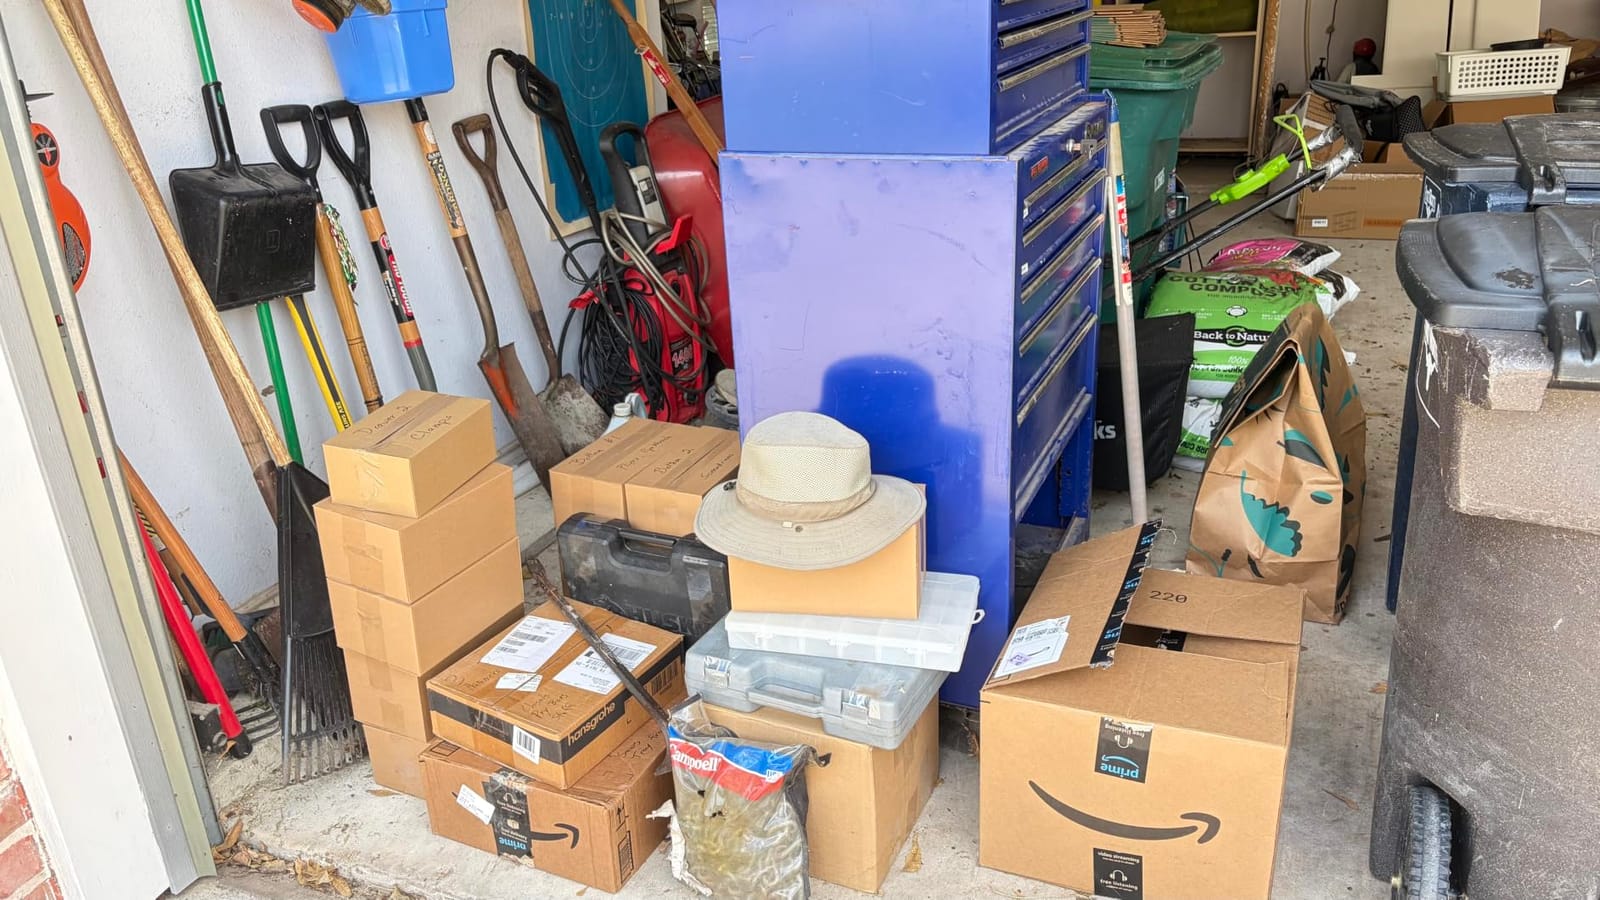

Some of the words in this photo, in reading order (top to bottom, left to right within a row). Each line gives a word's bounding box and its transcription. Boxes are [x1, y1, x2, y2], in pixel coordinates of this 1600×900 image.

[1194, 331, 1223, 341] Back
[1225, 332, 1236, 341] to
[410, 415, 453, 441] Clamps
[1148, 589, 1188, 604] 220
[567, 701, 616, 747] hansgrohe
[1099, 762, 1140, 780] prime
